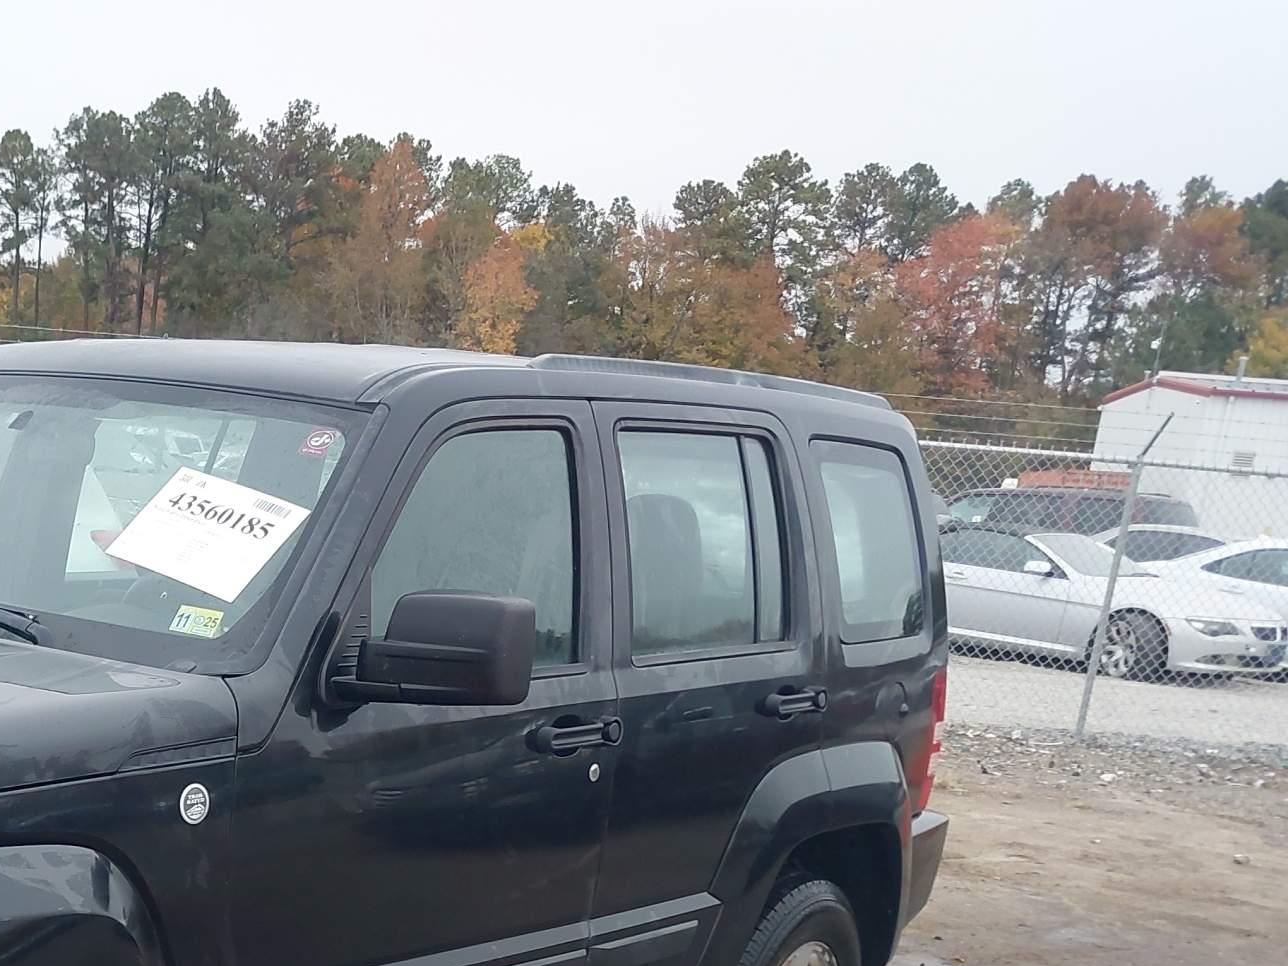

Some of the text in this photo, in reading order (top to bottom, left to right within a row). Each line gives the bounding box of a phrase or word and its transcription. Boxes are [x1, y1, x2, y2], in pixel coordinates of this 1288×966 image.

[169, 492, 275, 540] 43560185
[176, 613, 219, 629] 11 25
